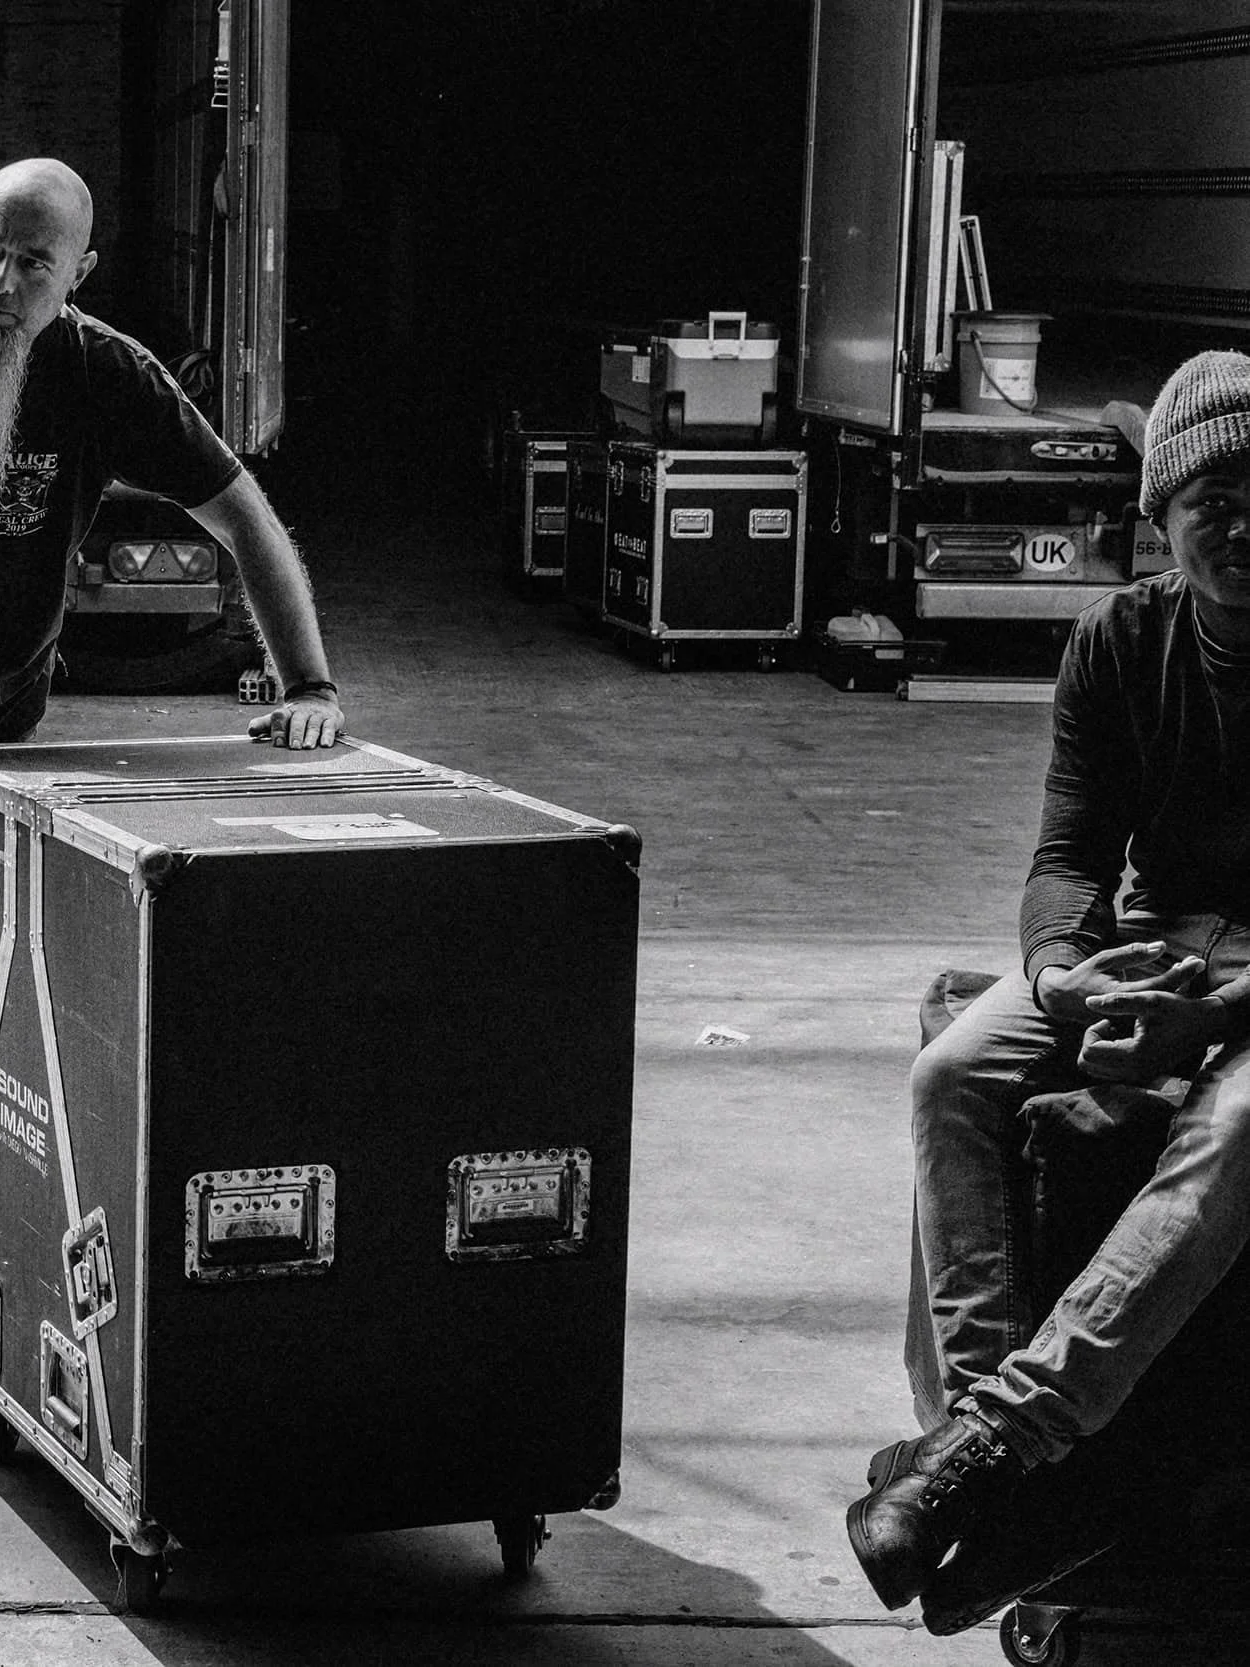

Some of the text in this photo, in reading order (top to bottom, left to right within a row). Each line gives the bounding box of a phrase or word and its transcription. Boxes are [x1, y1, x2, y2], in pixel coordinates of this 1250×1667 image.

[5, 453, 58, 469] ALICE
[5, 524, 28, 532] 2019
[1032, 540, 1067, 564] UK
[0, 1102, 46, 1157] IMAGE
